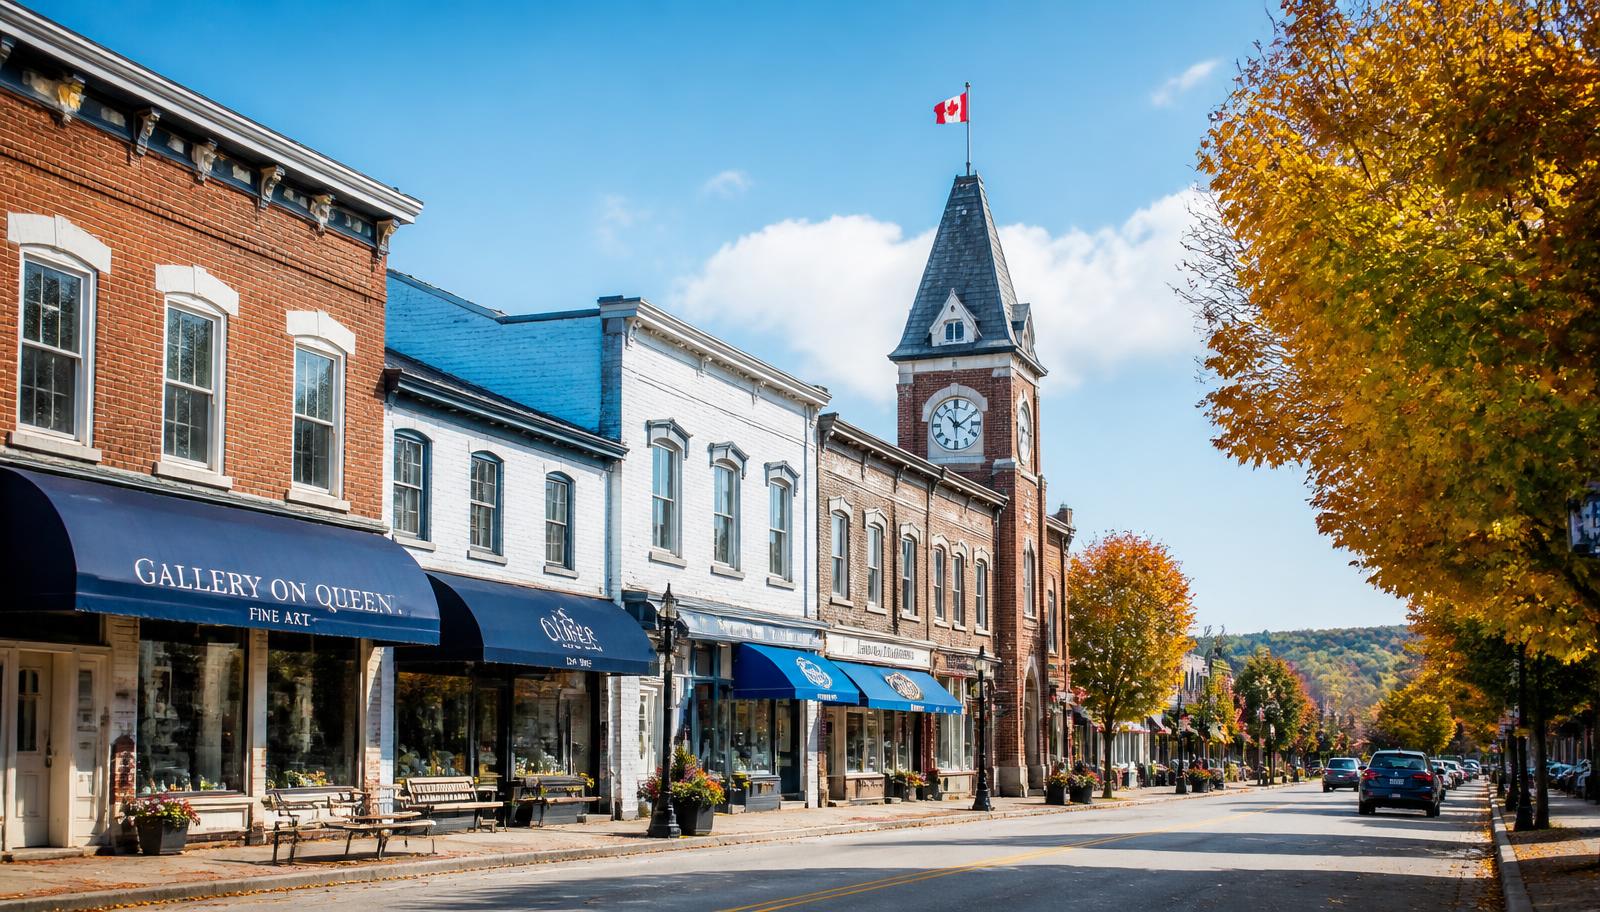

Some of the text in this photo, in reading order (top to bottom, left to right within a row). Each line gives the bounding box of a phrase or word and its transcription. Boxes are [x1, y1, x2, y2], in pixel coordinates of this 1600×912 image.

[134, 557, 262, 599] GALLERY
[270, 578, 307, 604] ON
[249, 607, 311, 627] FINE ART
